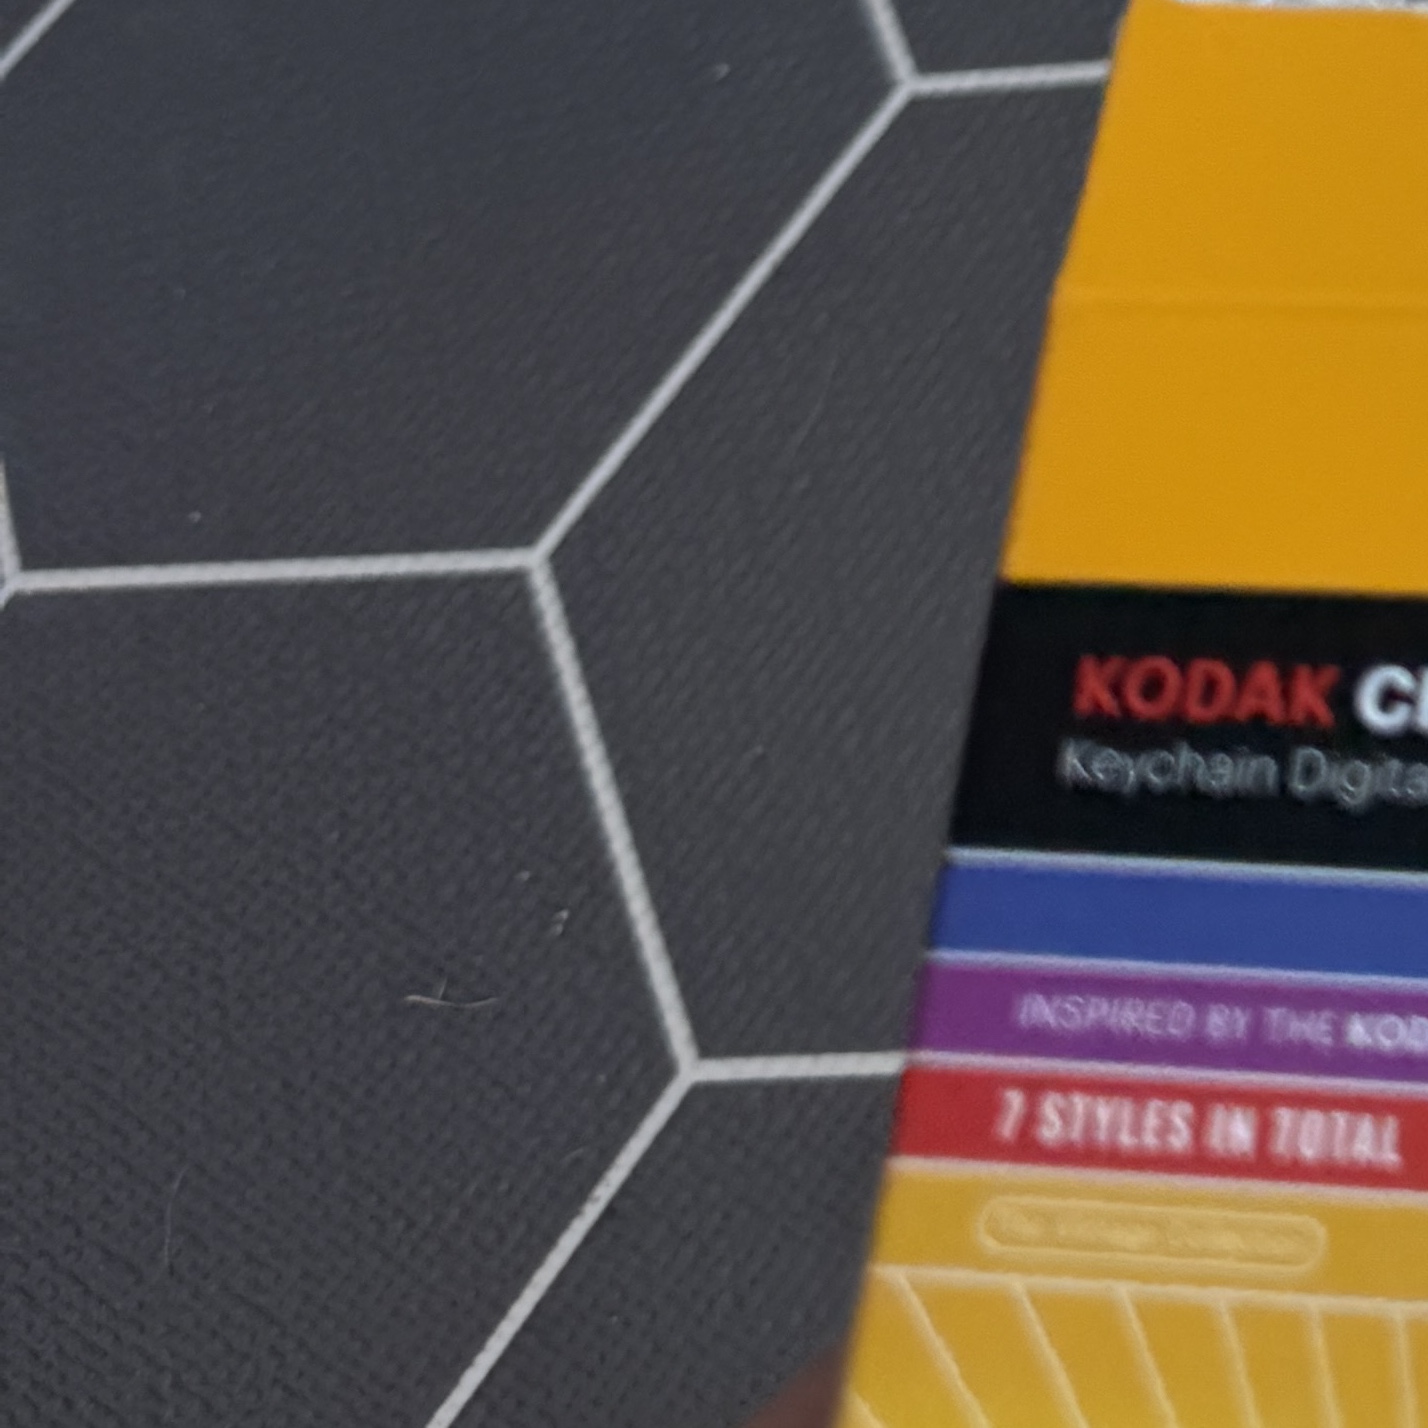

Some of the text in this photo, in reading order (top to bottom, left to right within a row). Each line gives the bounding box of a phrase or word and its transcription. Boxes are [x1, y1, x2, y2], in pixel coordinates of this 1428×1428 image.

[1072, 653, 1341, 727] KODAK
[1058, 738, 1280, 798] Keychain
[1015, 994, 1197, 1034] INSPIRED
[1207, 1004, 1256, 1042] BY
[1264, 1007, 1334, 1046] THE
[997, 1089, 1403, 1166] 7 STYLES IN TOTAL
